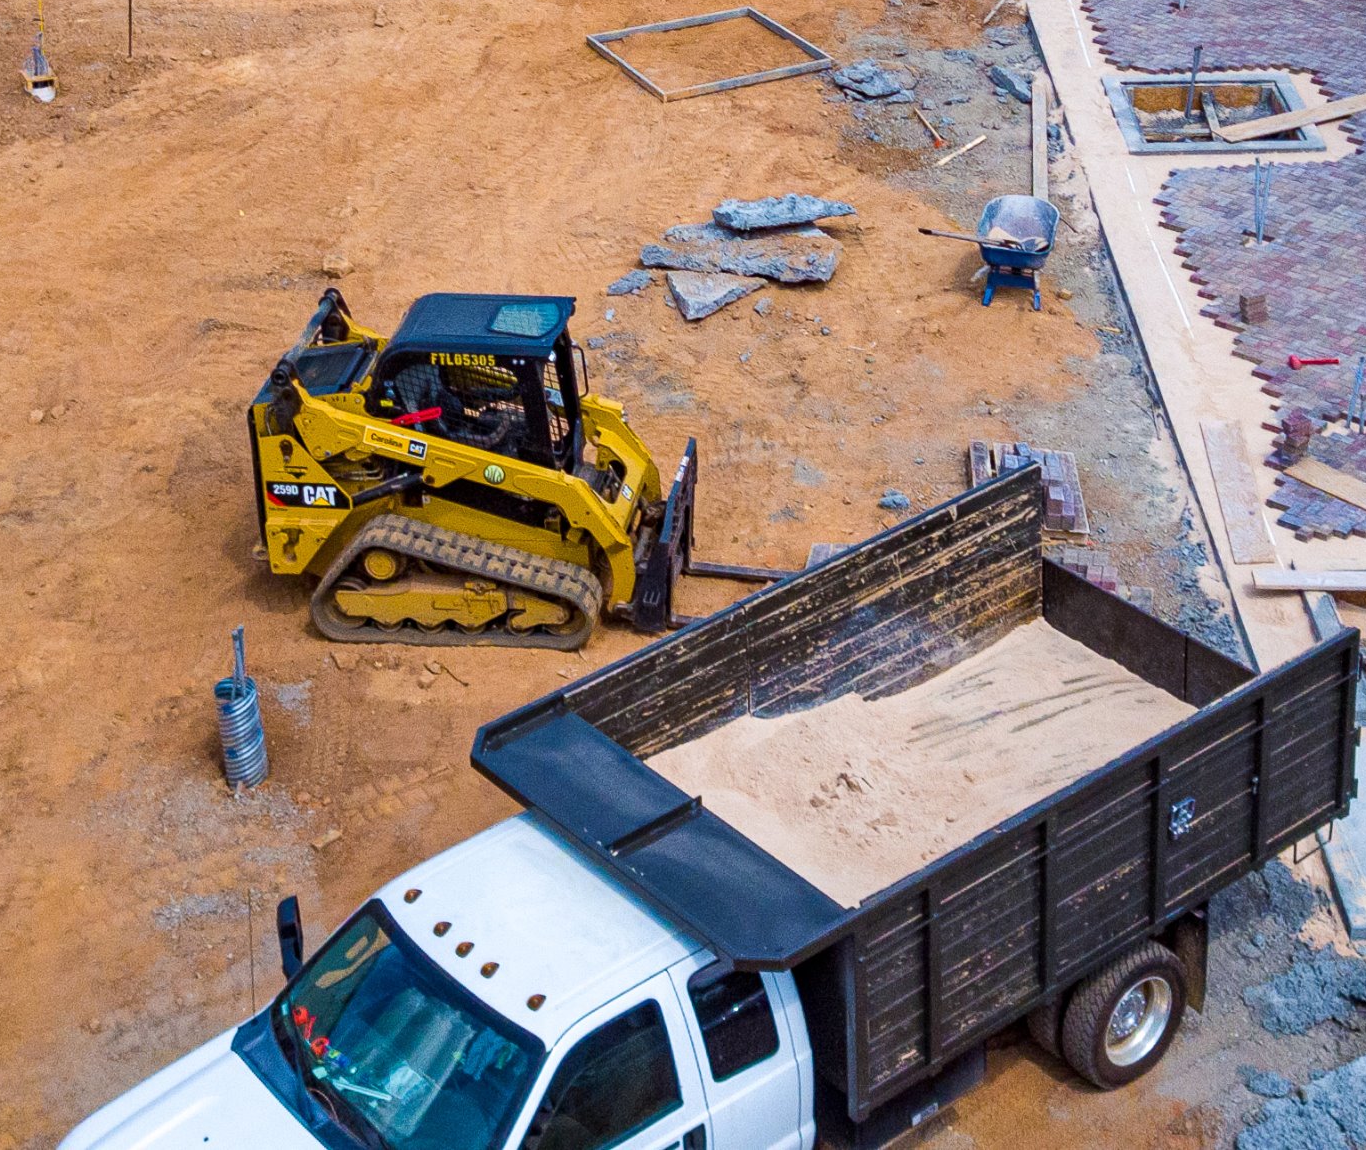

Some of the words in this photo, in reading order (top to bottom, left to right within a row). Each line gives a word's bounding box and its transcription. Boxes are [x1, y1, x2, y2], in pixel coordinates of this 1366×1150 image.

[409, 443, 425, 455] CAT
[272, 483, 299, 496] 259D
[302, 485, 337, 506] CAT
